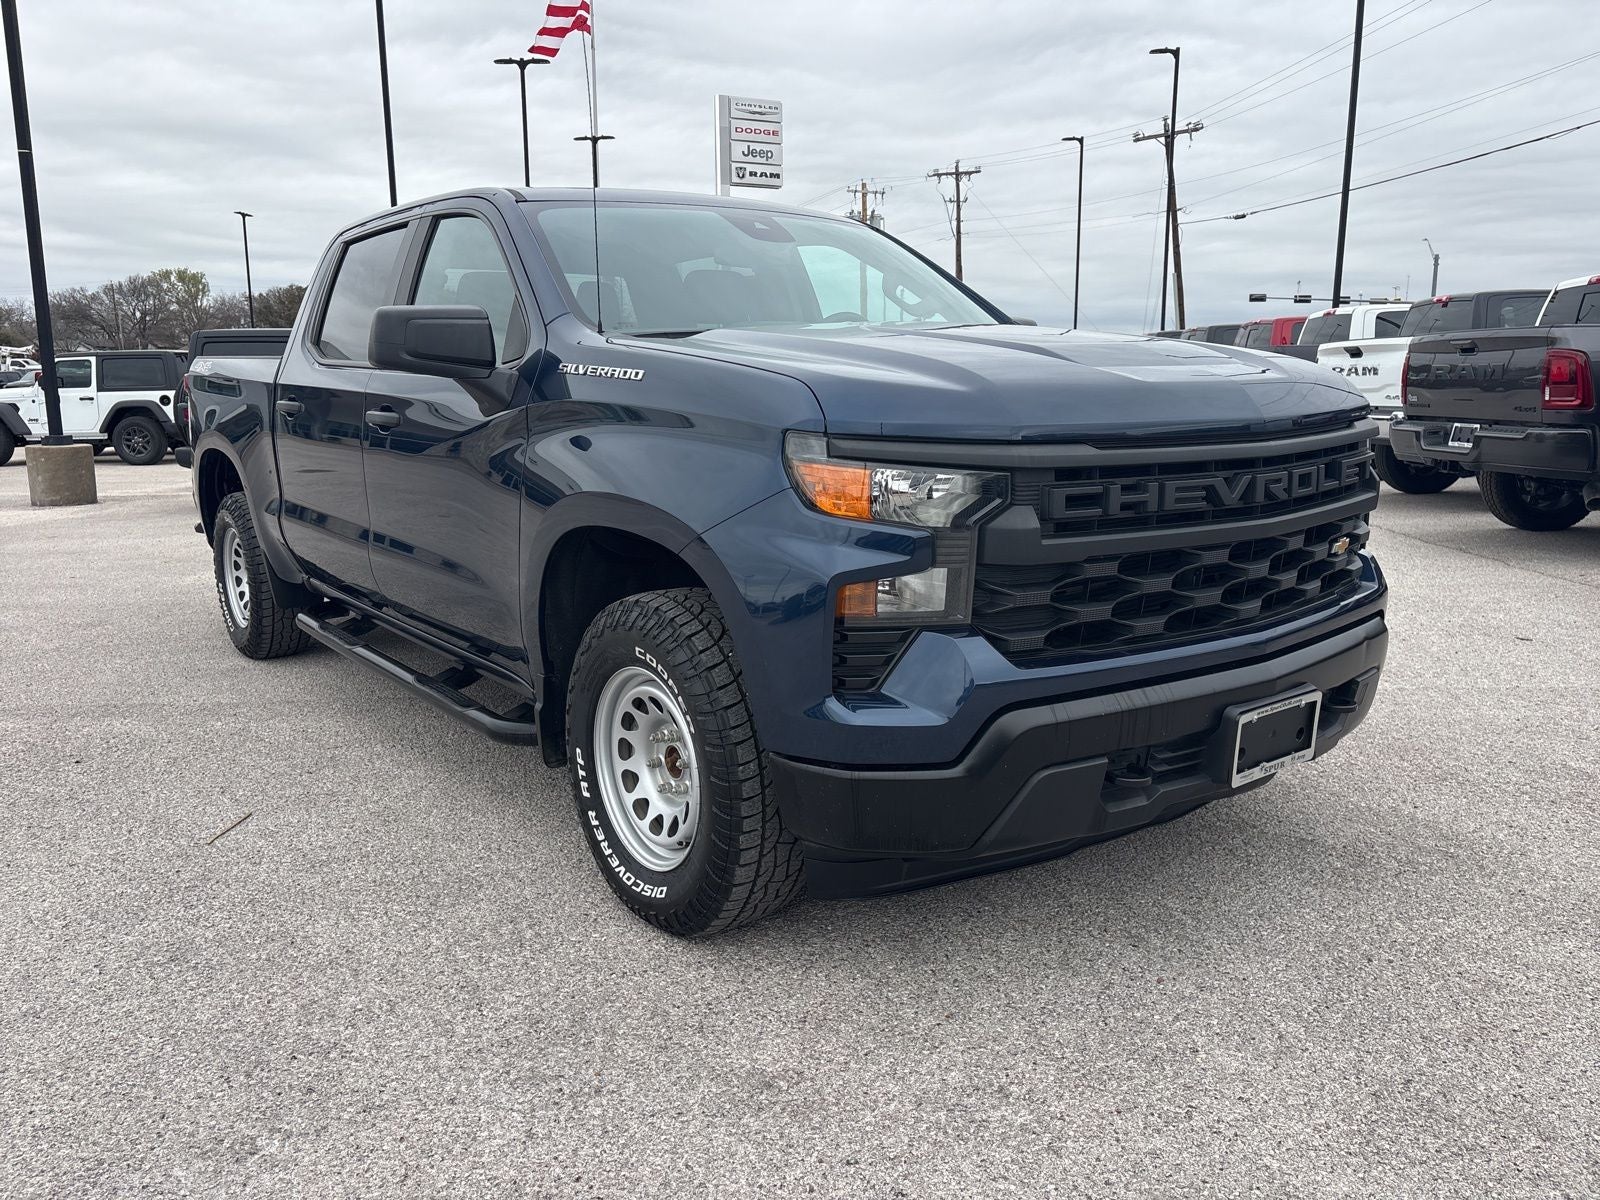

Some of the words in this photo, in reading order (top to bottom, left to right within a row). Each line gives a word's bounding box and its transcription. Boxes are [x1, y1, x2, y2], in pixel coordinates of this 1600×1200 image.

[735, 102, 779, 111] CHRYSLER
[735, 127, 779, 137] DODGE
[742, 144, 774, 161] Jeep
[748, 171, 781, 179] RAM
[558, 363, 645, 381] SILVERADO
[1430, 363, 1506, 381] RAM
[1042, 452, 1375, 521] CHEVROLET
[634, 646, 696, 735] COOPER
[575, 747, 591, 798] ATP
[587, 810, 668, 899] DISCOVERER
